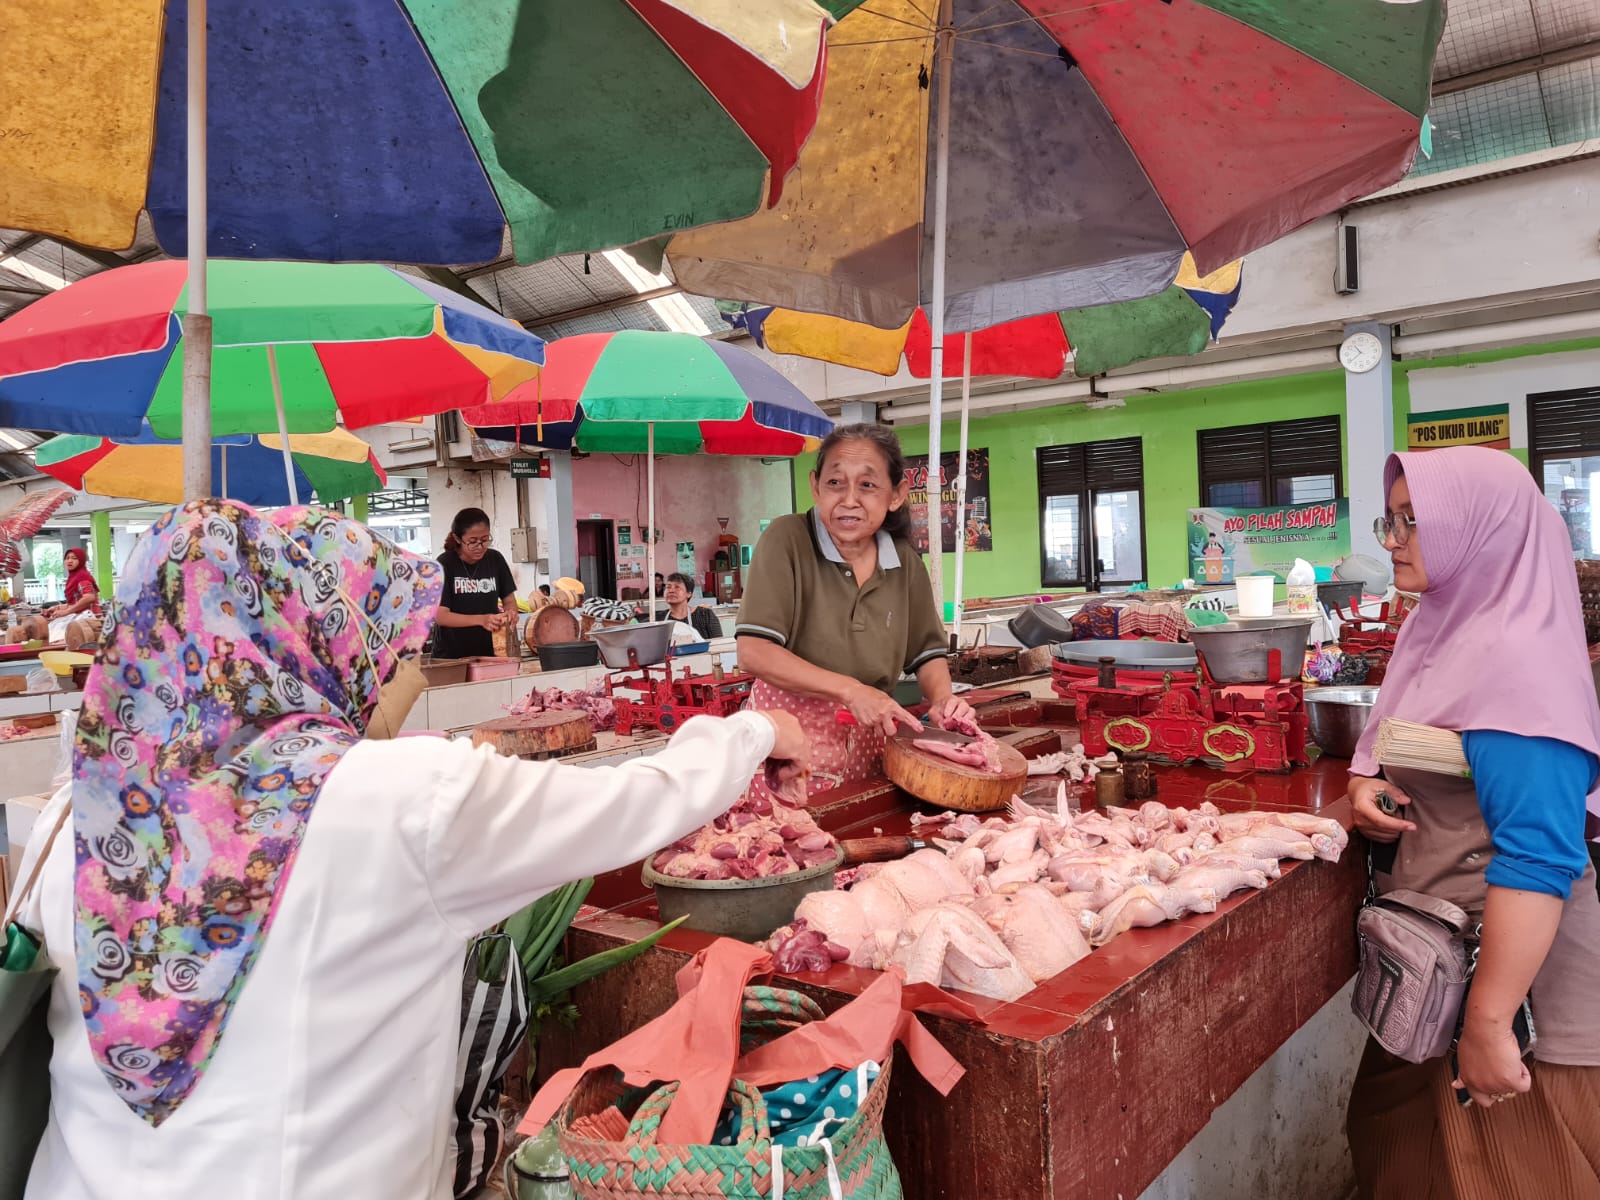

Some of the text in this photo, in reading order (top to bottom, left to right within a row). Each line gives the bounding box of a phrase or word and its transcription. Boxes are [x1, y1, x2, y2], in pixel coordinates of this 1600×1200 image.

[1439, 423, 1465, 440] UKUR
[1224, 503, 1338, 533] AYO PILAH SAMPAH
[1271, 532, 1310, 544] JENISNYA
[454, 577, 497, 594] PASSION
